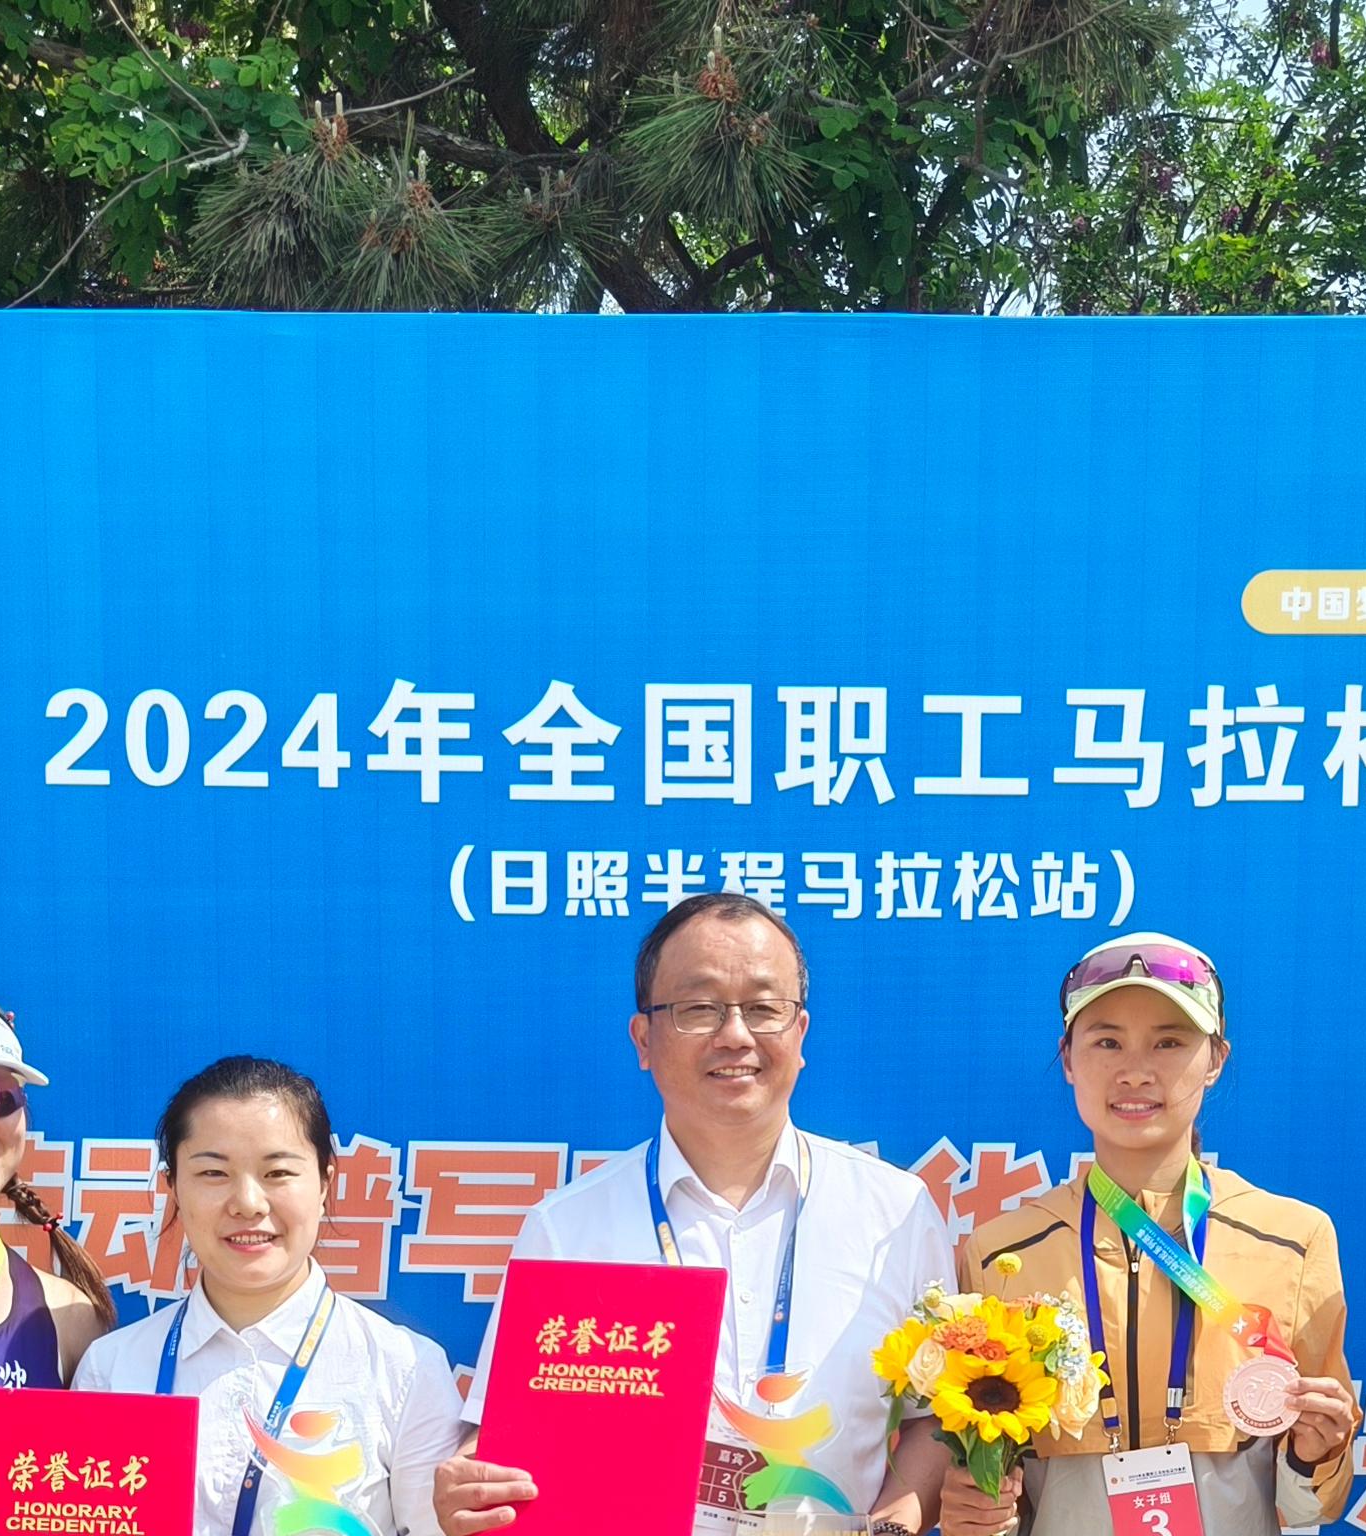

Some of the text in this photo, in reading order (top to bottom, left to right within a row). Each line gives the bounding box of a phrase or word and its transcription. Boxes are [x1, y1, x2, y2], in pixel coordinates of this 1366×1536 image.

[535, 1315, 676, 1359] 荣誉证书
[537, 1362, 660, 1383] HONORARY
[528, 1376, 665, 1398] CREDENTIAL
[7, 1449, 150, 1496] 荣誉证书
[721, 1473, 731, 1486] 2
[717, 1491, 728, 1503] 5
[1133, 1492, 1172, 1509] 女子组
[14, 1501, 138, 1520] HONORARY
[5, 1517, 145, 1536] CREDENTIAL
